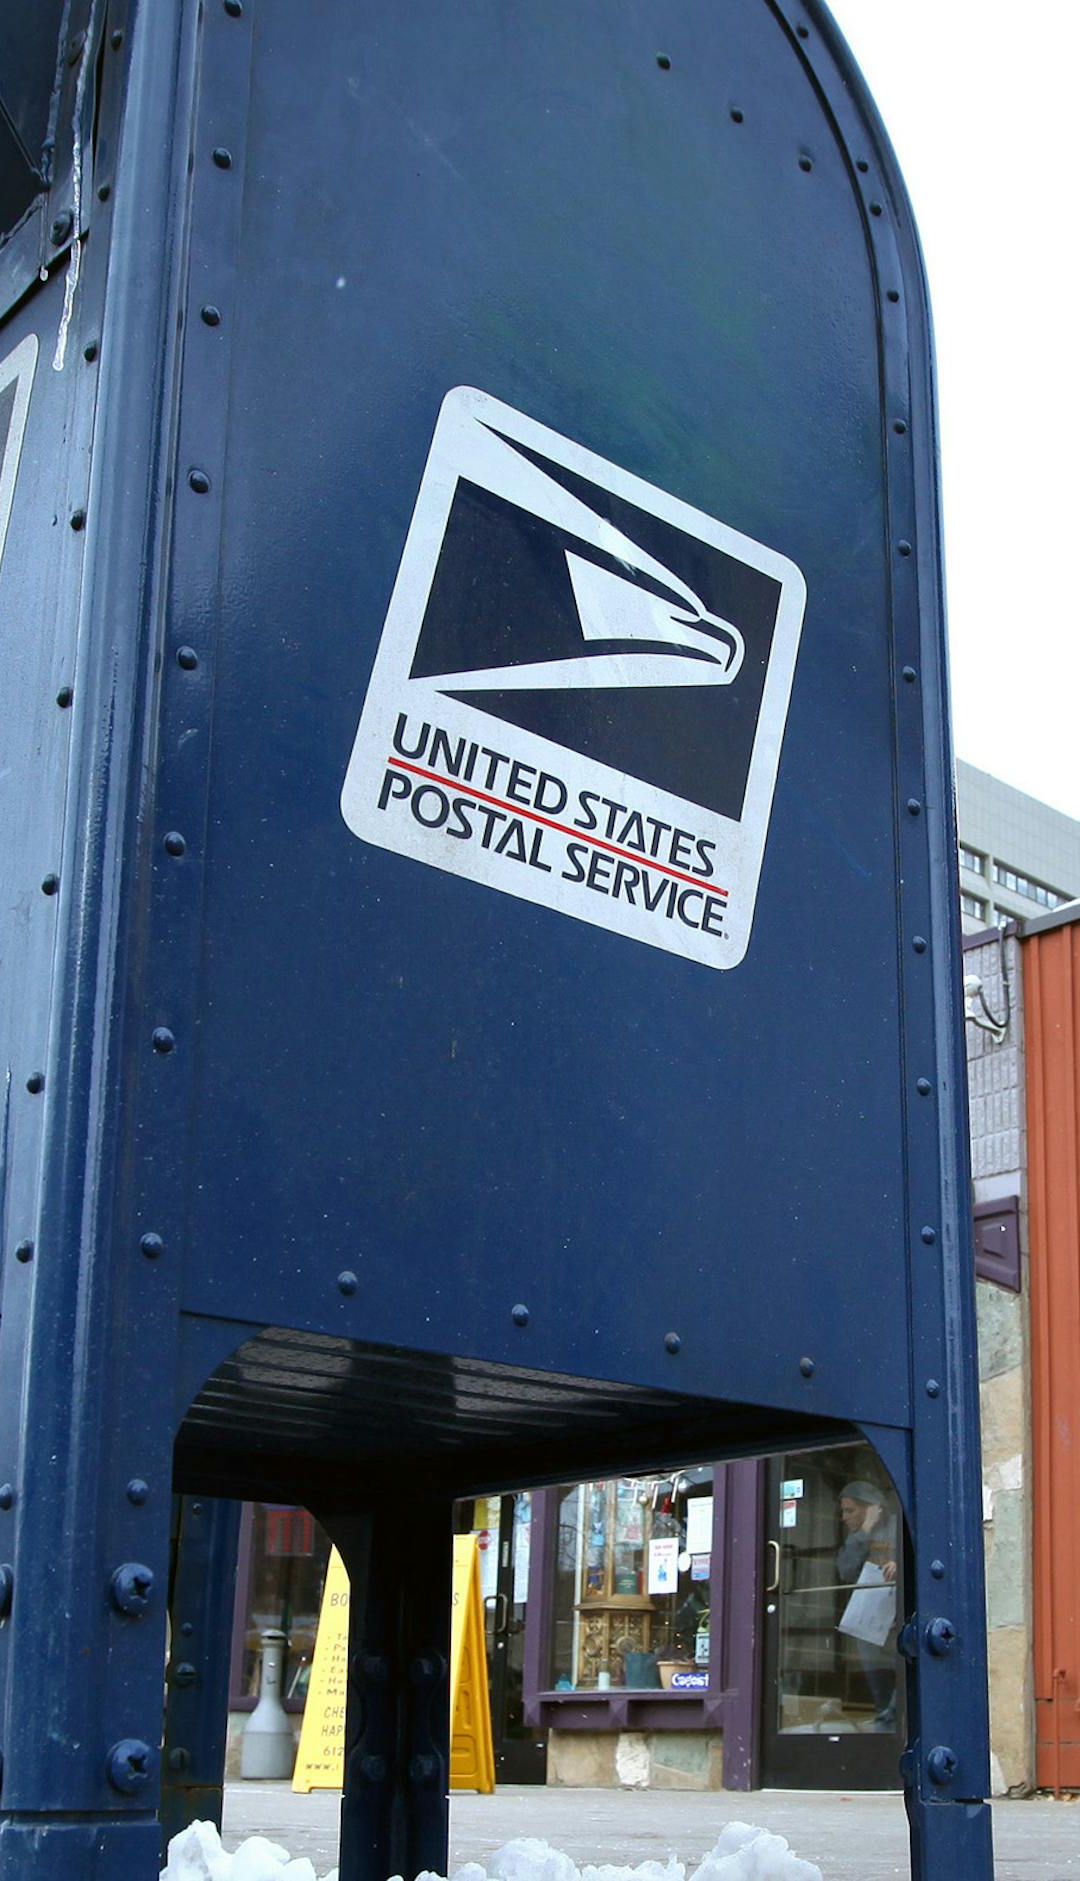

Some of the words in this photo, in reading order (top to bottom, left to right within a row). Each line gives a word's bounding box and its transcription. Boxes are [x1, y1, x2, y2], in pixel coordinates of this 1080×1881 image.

[392, 711, 568, 815] UNITED
[573, 790, 716, 878] STATES
[377, 768, 552, 873] POSTAL
[561, 842, 728, 937] SERVICE
[321, 1724, 344, 1737] HAP
[323, 1706, 344, 1719] CHE
